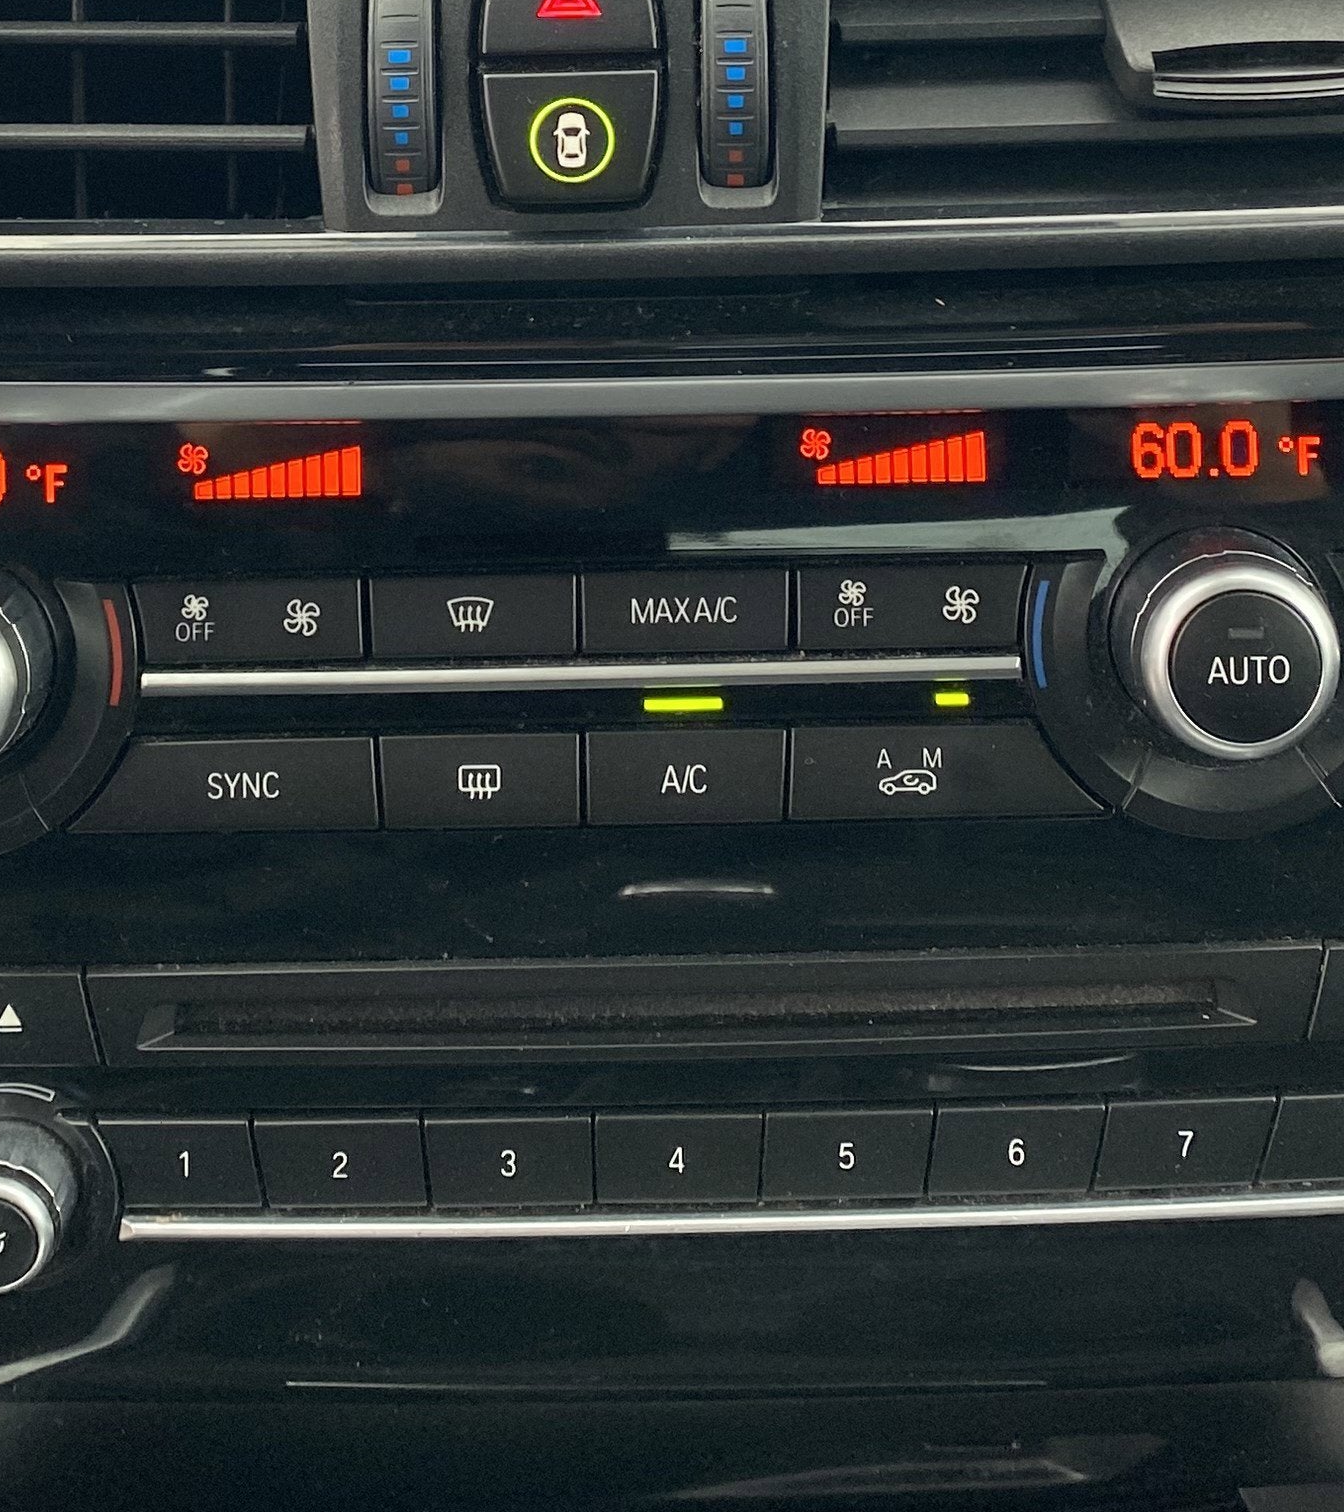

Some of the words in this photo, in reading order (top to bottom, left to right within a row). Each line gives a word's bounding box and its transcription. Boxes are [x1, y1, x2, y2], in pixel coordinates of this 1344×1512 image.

[1132, 420, 1258, 480] 60.0
[630, 598, 691, 624] MAX
[693, 596, 737, 624] A/C
[833, 607, 874, 627] OFF
[174, 621, 216, 643] OFF
[1207, 655, 1291, 685] AUTO
[876, 748, 892, 769] A
[922, 747, 942, 768] M
[206, 771, 281, 802] SYNC
[661, 765, 707, 794] A/C
[837, 1143, 855, 1170] 5
[1008, 1138, 1026, 1166] 6
[1177, 1131, 1194, 1158] 7
[179, 1152, 191, 1178] 1
[331, 1152, 349, 1179] 2
[499, 1150, 517, 1178] 3
[667, 1146, 686, 1175] 4
